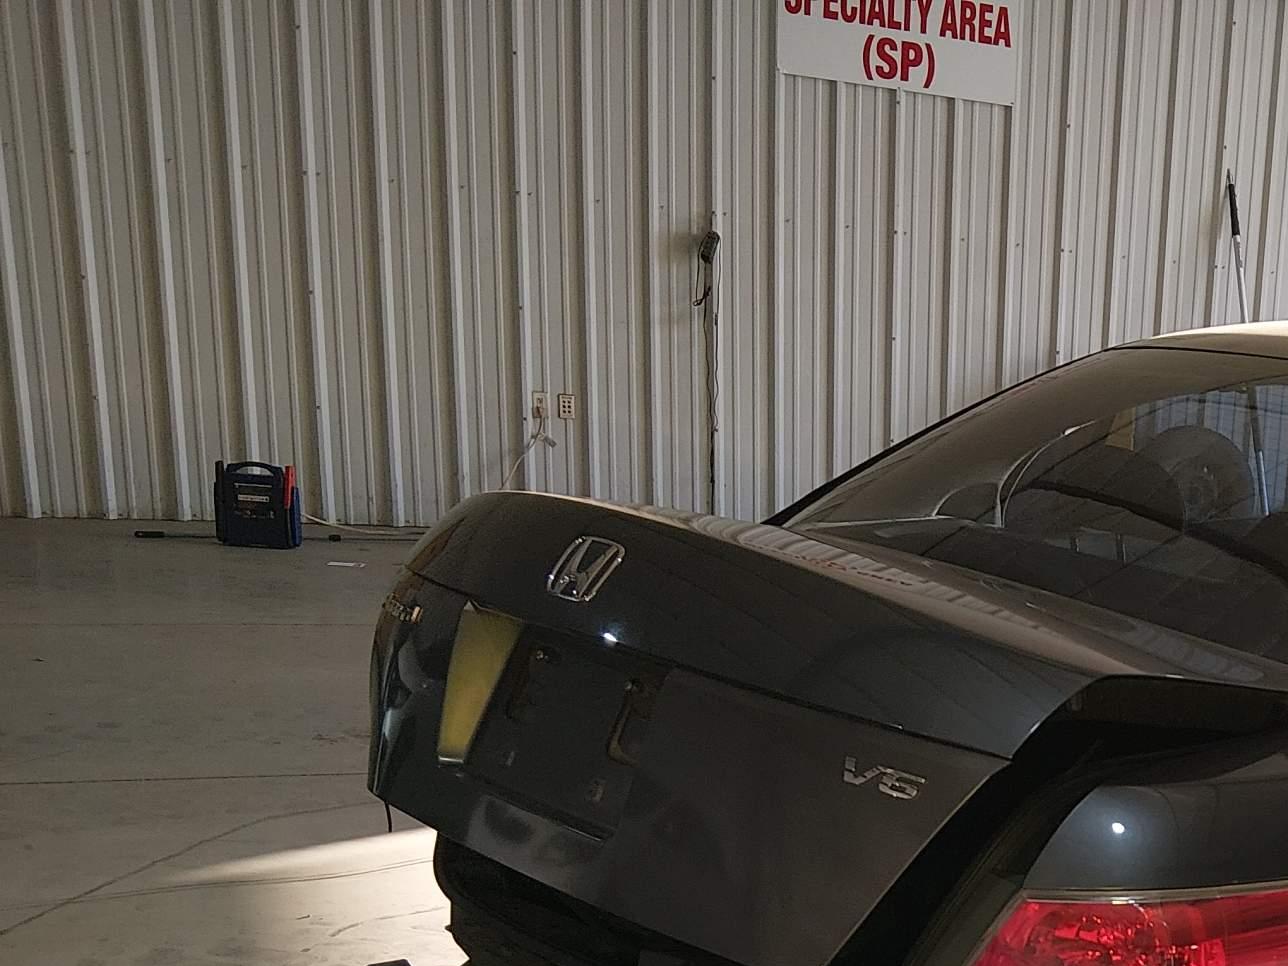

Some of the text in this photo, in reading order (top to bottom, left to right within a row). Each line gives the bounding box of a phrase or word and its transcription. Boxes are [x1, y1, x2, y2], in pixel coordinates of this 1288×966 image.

[939, 0, 1012, 48] AREA
[862, 34, 935, 89] (SP)
[843, 755, 926, 799] V6
